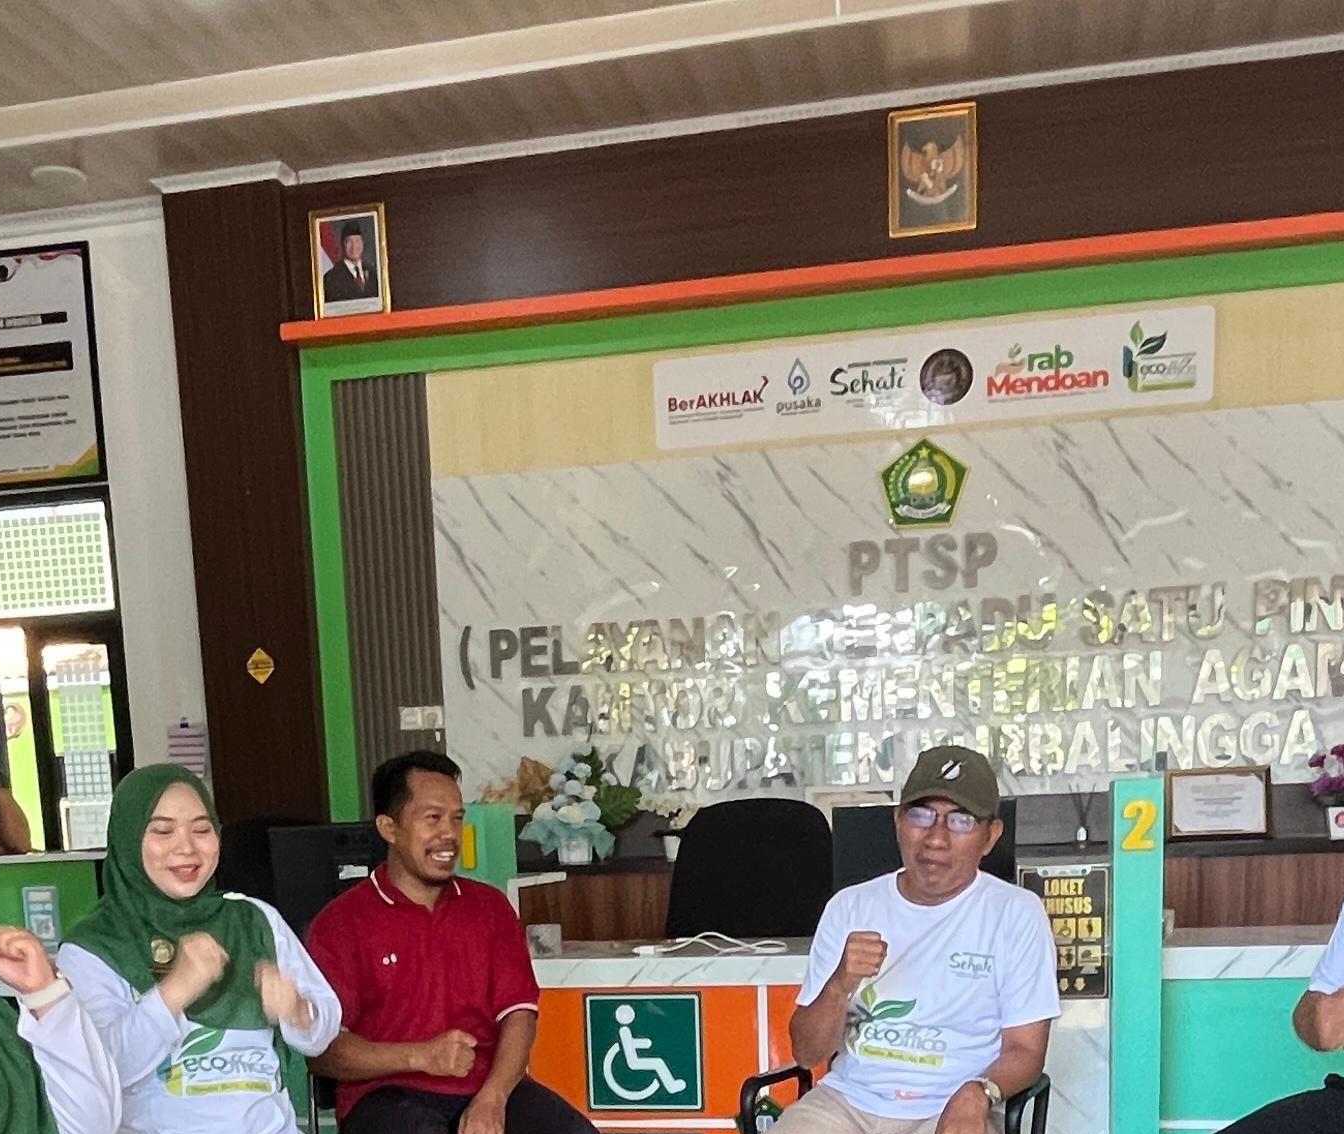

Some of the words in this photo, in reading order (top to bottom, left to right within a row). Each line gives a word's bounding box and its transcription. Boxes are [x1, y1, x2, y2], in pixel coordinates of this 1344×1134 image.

[667, 375, 769, 413] BerAKHLAK
[829, 365, 906, 396] Sehati
[986, 368, 1109, 397] Mendoan
[776, 396, 822, 414] pusaka
[847, 531, 998, 596] PTSP
[488, 611, 782, 679] PELAYANAN
[1082, 582, 1226, 648] SATU
[522, 677, 737, 738] KANTOR
[763, 650, 1162, 728] KEMENTERIAN
[1121, 800, 1157, 850] 2
[1044, 878, 1085, 897] LOKET
[1042, 896, 1093, 915] HUSUS
